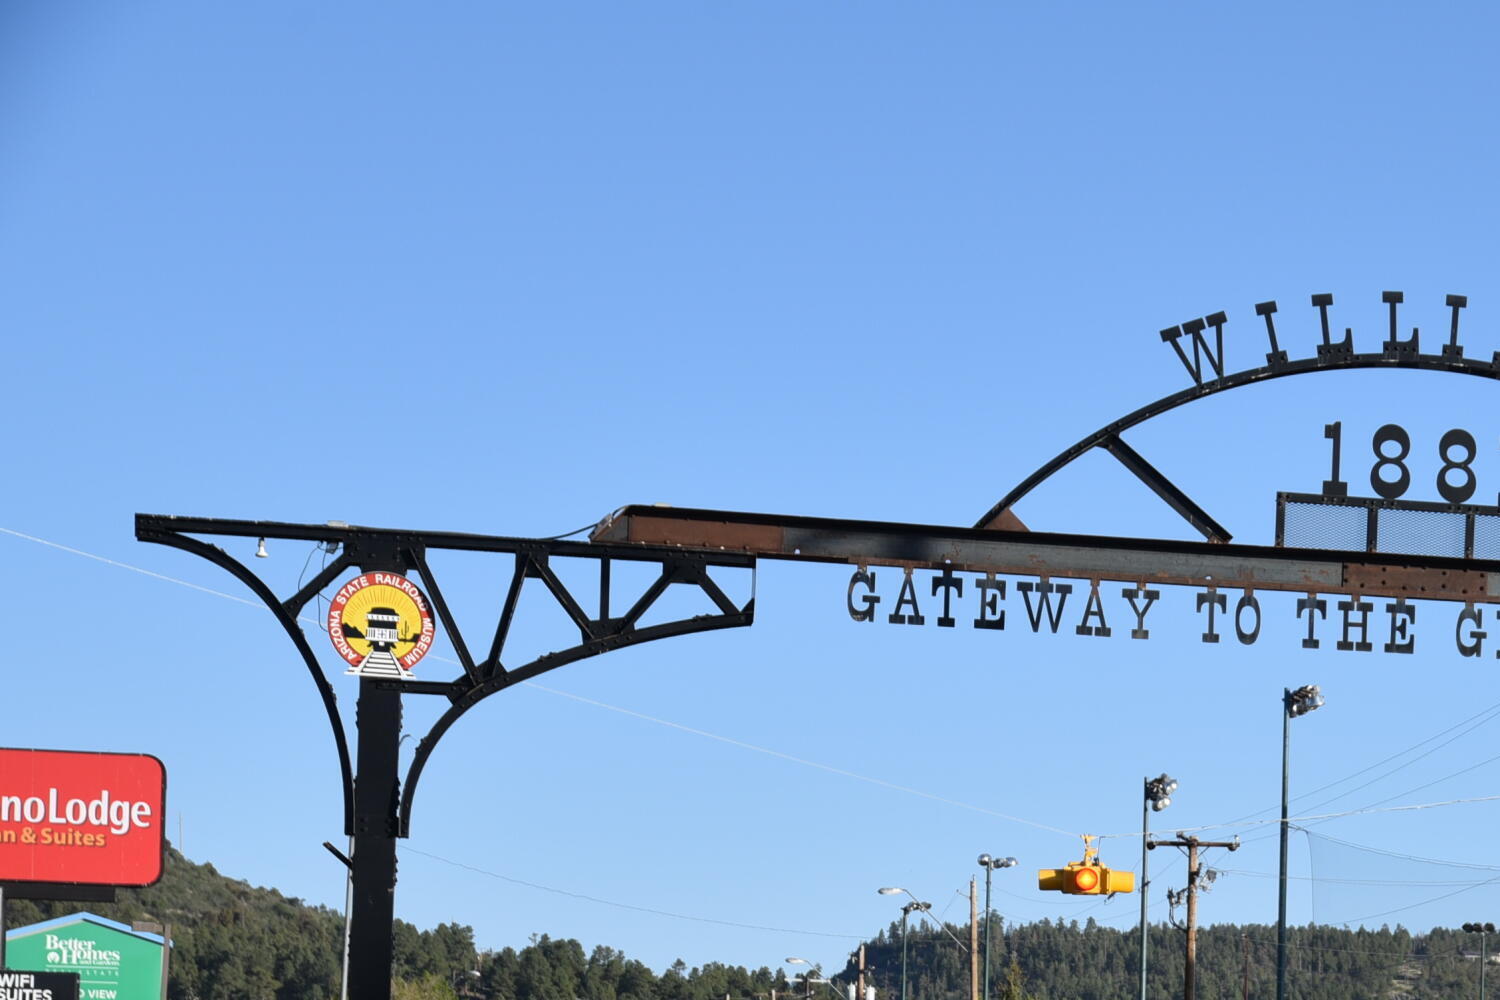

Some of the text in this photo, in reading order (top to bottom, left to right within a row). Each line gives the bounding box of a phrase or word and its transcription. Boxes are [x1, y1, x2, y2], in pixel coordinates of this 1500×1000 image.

[329, 573, 434, 666] ARIZONA STATE RAILROAD MUSEUM
[847, 568, 1161, 641] GATEWAY
[1196, 588, 1261, 646] TO
[1297, 597, 1415, 655] THE
[21, 826, 36, 844] &
[41, 827, 105, 847] Suites
[46, 934, 96, 951] Better
[61, 948, 121, 965] Homes
[0, 973, 35, 989] WIFI
[89, 989, 117, 1000] VIEW
